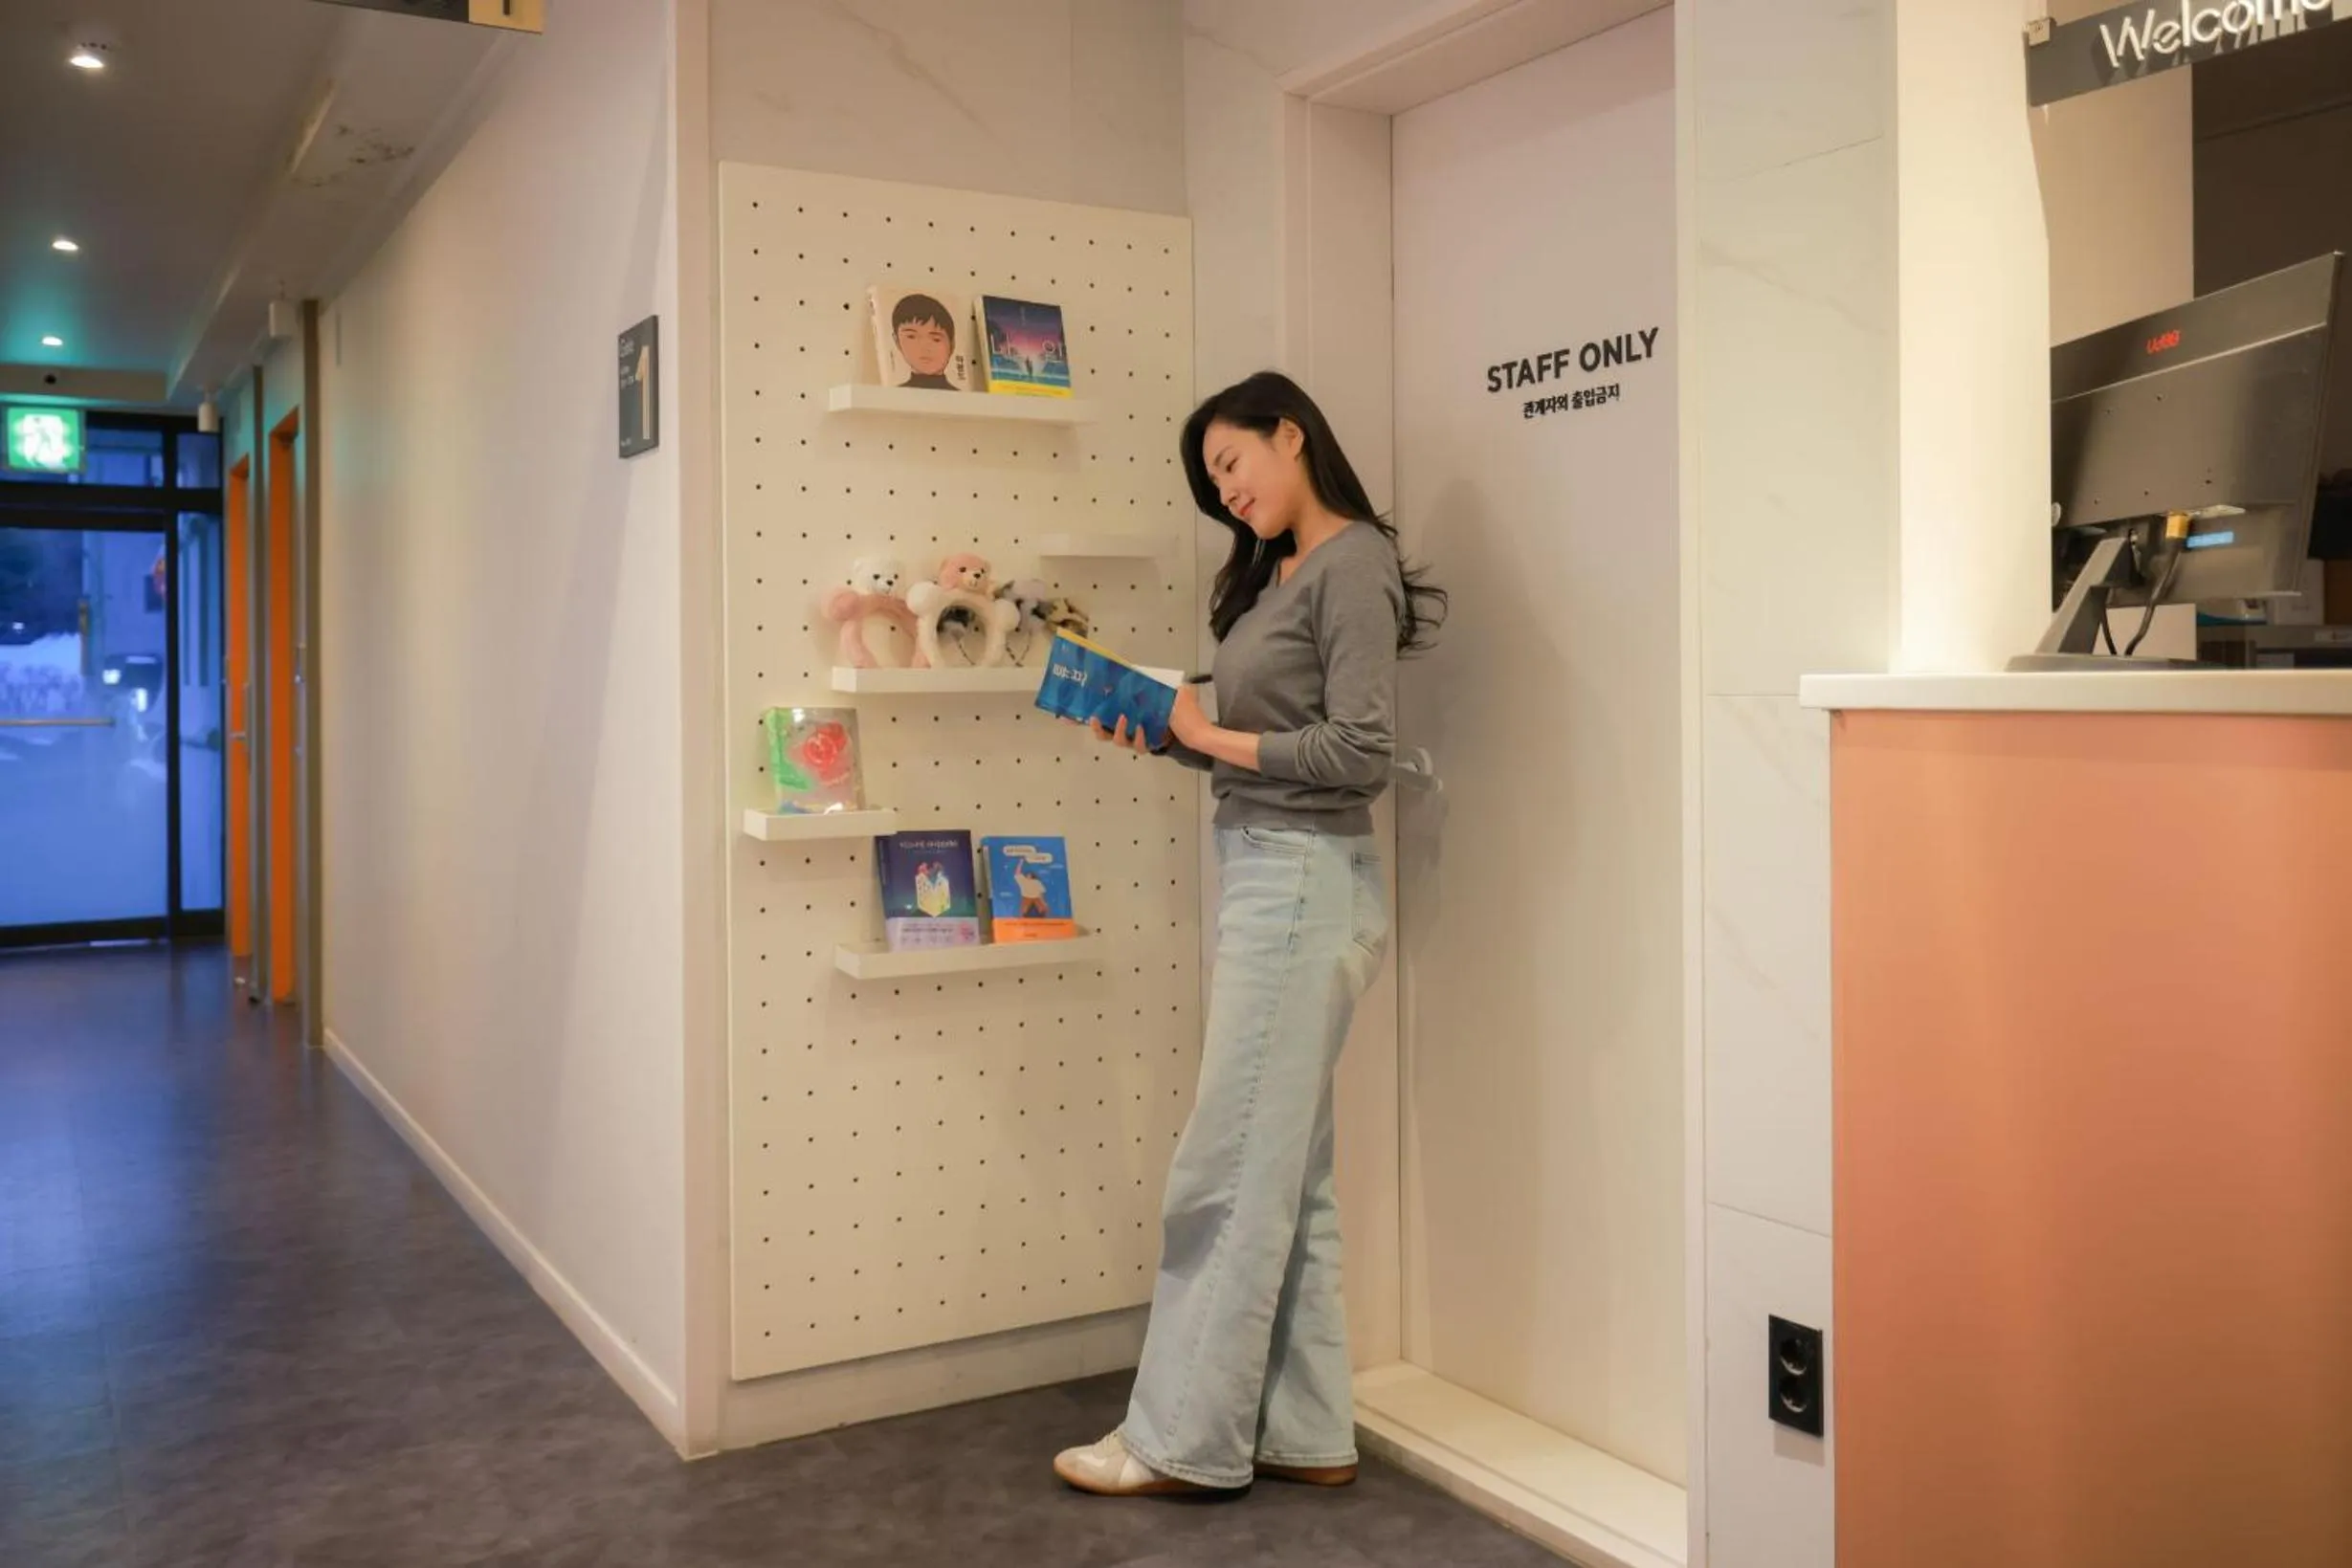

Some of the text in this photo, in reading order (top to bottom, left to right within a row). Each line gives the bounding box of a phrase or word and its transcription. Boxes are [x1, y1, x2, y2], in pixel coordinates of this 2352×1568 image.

[2099, 0, 2332, 68] Welcom
[635, 345, 651, 440] 1
[1487, 326, 1659, 393] STAFF ONLY
[1571, 384, 1620, 410] 출입금지
